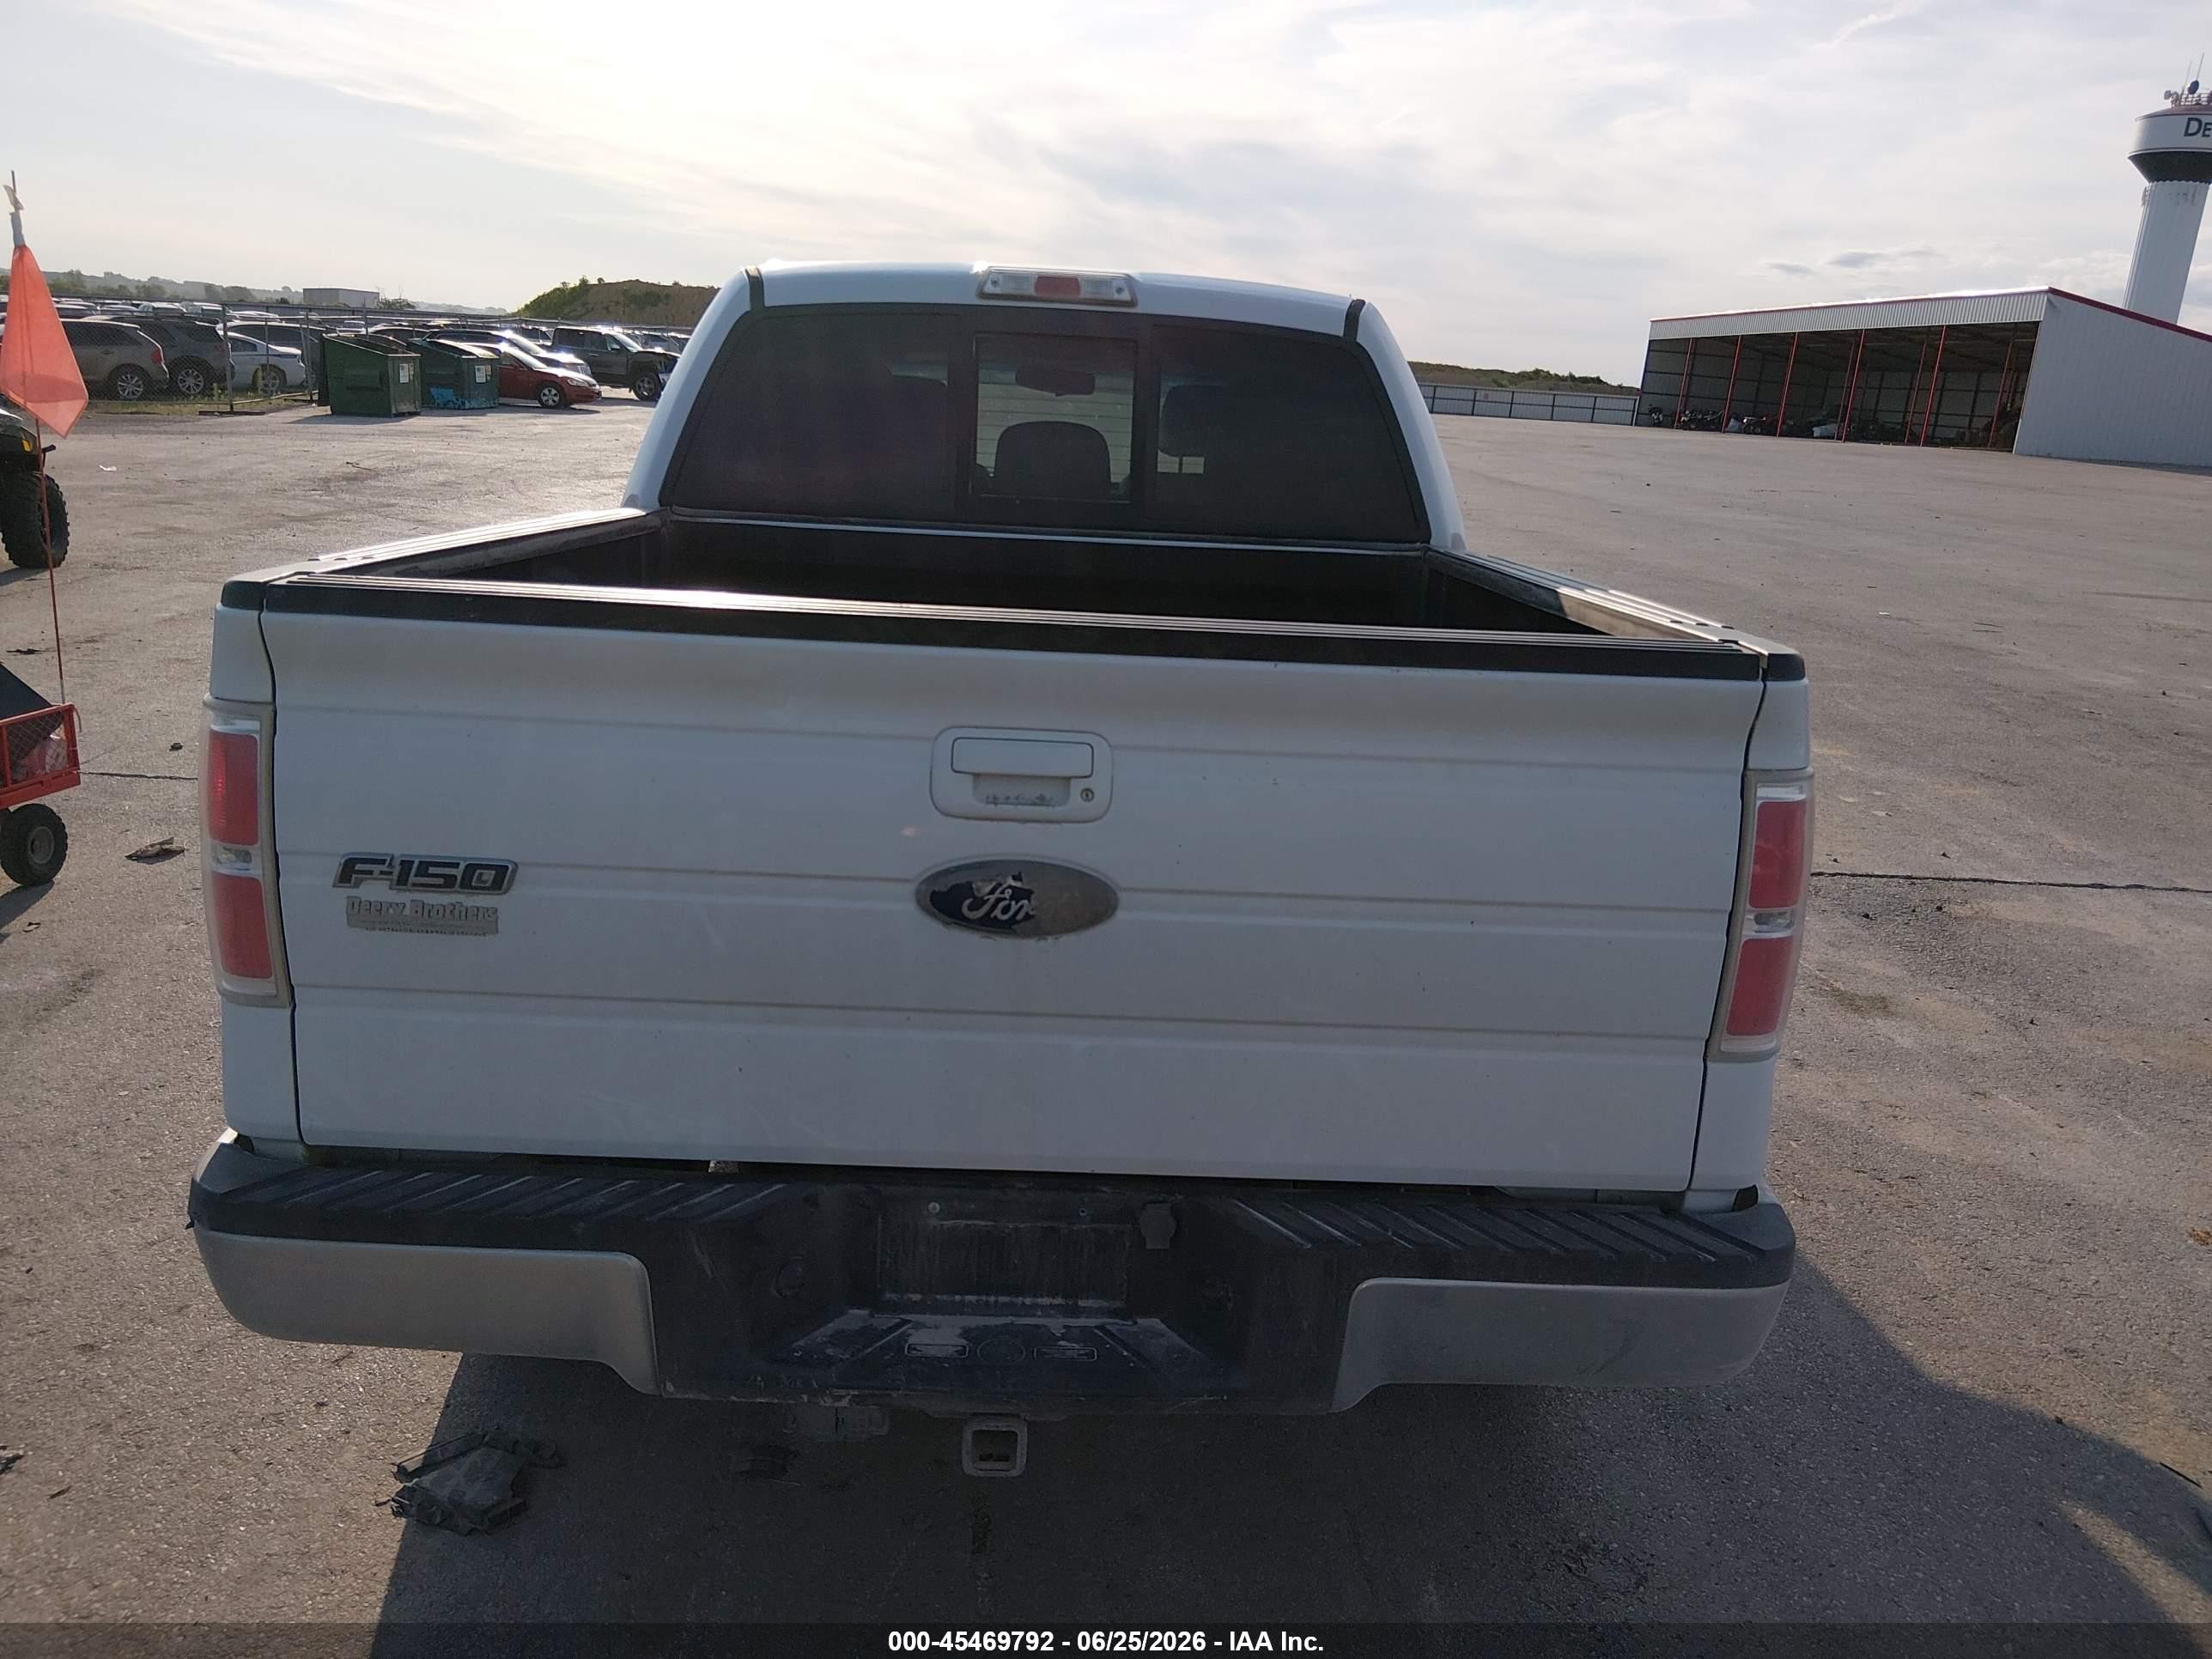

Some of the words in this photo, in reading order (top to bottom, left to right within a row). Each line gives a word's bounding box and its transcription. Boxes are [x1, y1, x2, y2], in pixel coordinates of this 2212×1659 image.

[332, 852, 519, 895] F-150
[410, 899, 498, 921] Brothers
[961, 873, 1036, 921] For
